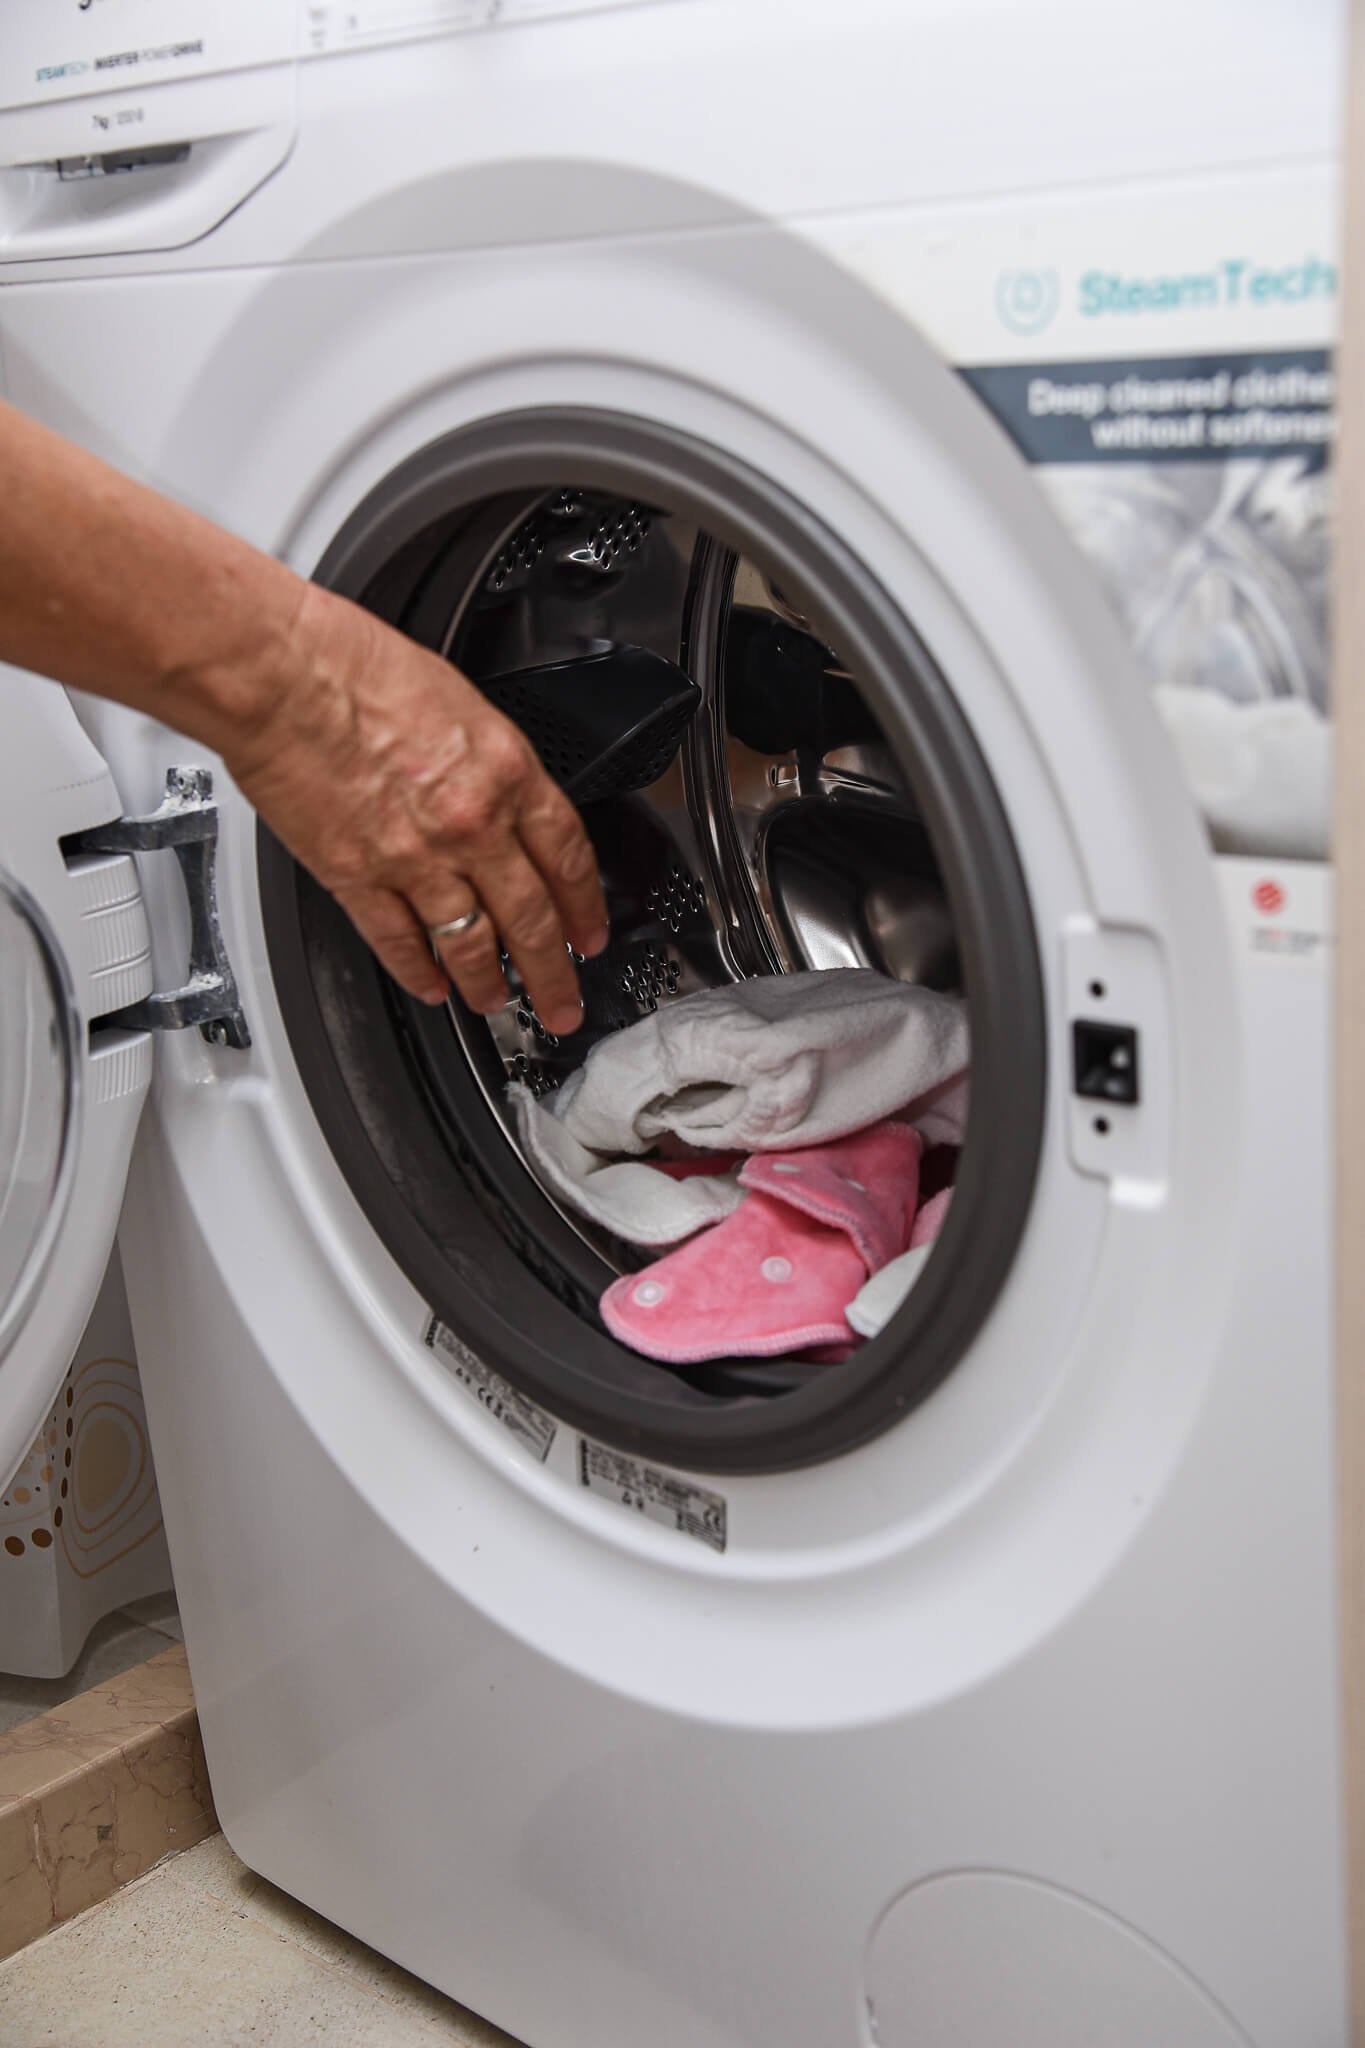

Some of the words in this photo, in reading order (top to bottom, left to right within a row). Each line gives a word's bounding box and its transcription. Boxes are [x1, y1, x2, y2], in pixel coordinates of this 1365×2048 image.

[1079, 251, 1339, 316] SteamTech
[1028, 377, 1106, 420] Deep
[1108, 370, 1231, 415] cleaned
[1233, 367, 1336, 408] clothe
[1090, 413, 1206, 449] without
